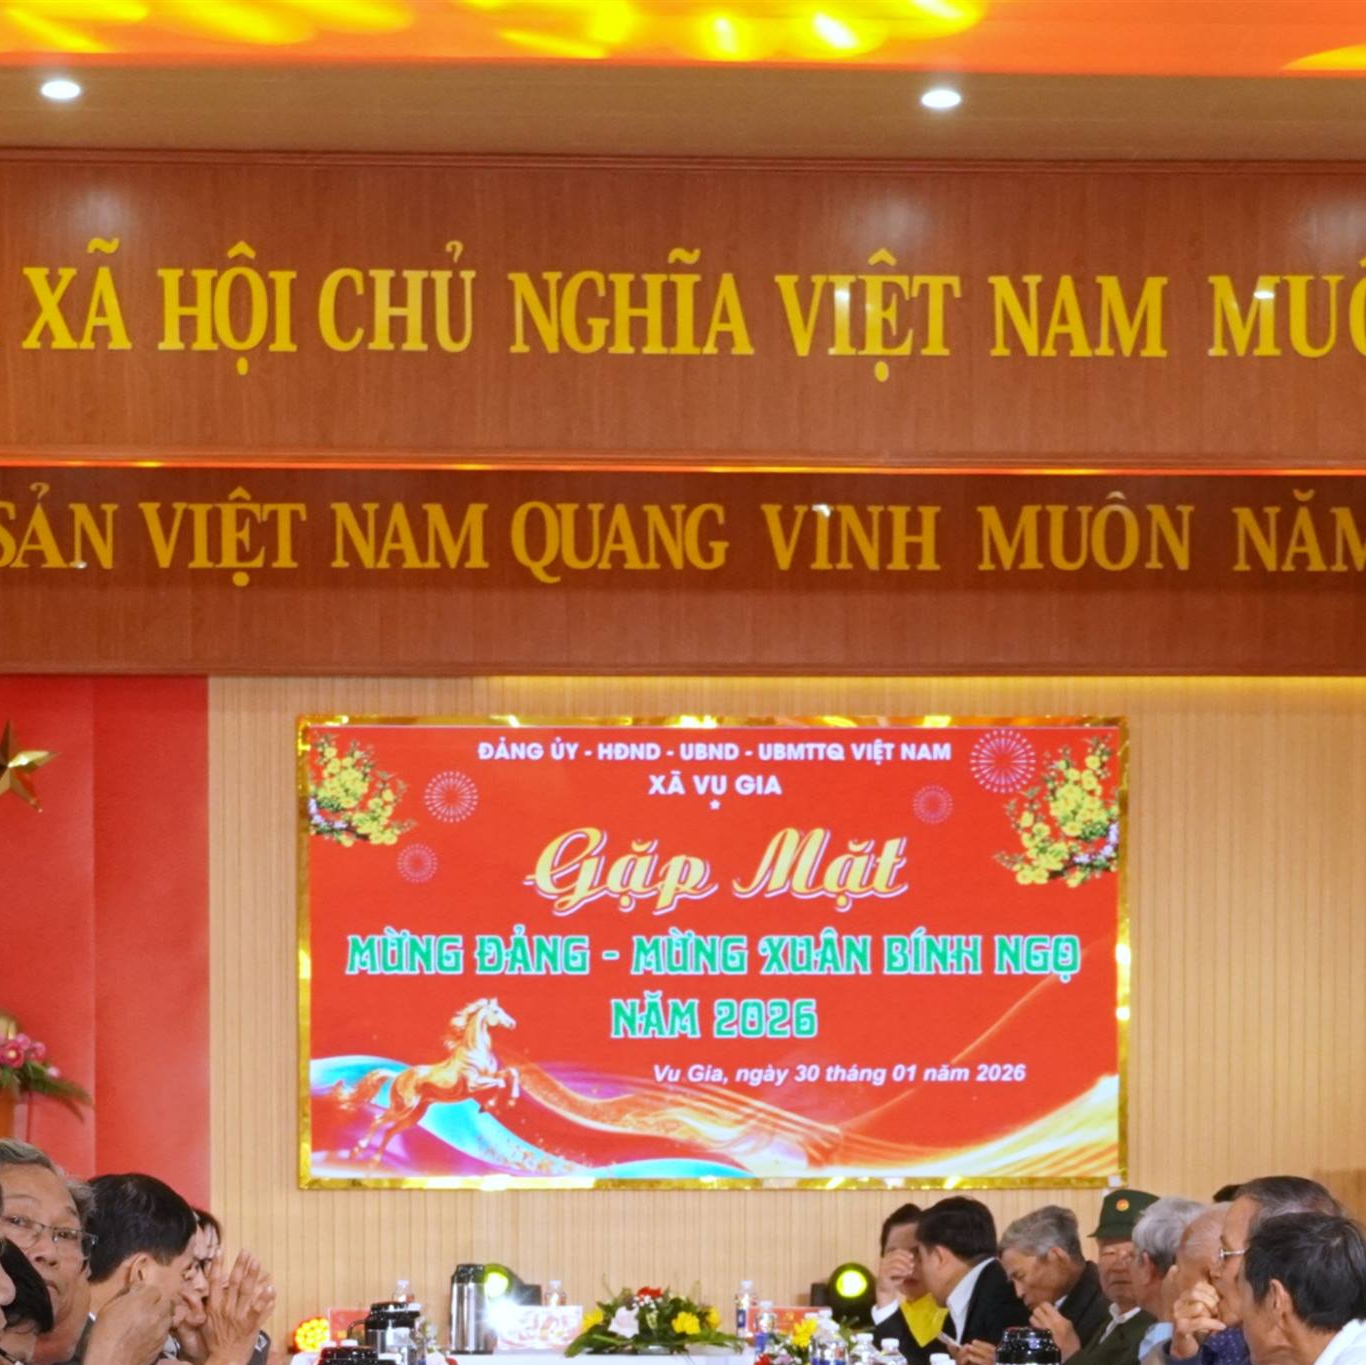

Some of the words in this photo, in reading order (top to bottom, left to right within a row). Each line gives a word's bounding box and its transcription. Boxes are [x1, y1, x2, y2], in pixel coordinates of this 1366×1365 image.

[21, 237, 133, 350] XÃ
[156, 242, 298, 376] HỘI
[317, 240, 476, 353] CHỦ
[509, 247, 754, 356] NGHĨA
[774, 248, 962, 382] VIỆT
[989, 274, 1168, 358] NAM
[141, 486, 307, 587] VIỆT
[332, 502, 487, 569] NAM
[510, 502, 729, 583] QUANG
[761, 504, 939, 571] VINH
[978, 490, 1194, 571] MUÔN
[477, 736, 545, 761] ĐẢNG
[550, 735, 579, 761] ỦY
[597, 742, 661, 761] HĐND
[680, 742, 739, 761] UBND
[759, 742, 844, 762] UBMTTQ
[851, 739, 895, 766] VIỆT
[900, 743, 952, 762] NAM
[647, 770, 686, 796] XÃ
[733, 774, 783, 796] GIA
[524, 826, 718, 915] Gặp
[732, 826, 908, 914] Mặt
[345, 925, 465, 976] MỪNG
[474, 923, 590, 976] ĐẢNG
[630, 925, 749, 976] MỪNG
[757, 925, 873, 976] XUÂN
[883, 925, 983, 976] BÍNH
[994, 934, 1082, 984] NGỌ
[610, 990, 702, 1039] NĂM
[712, 997, 819, 1039] 2026
[687, 1063, 729, 1087] Gia,
[735, 1064, 789, 1088] ngày
[794, 1064, 821, 1083] 30
[826, 1063, 886, 1088] tháng
[892, 1064, 918, 1083] 01
[922, 1064, 971, 1083] năm
[976, 1064, 1027, 1083] 2026
